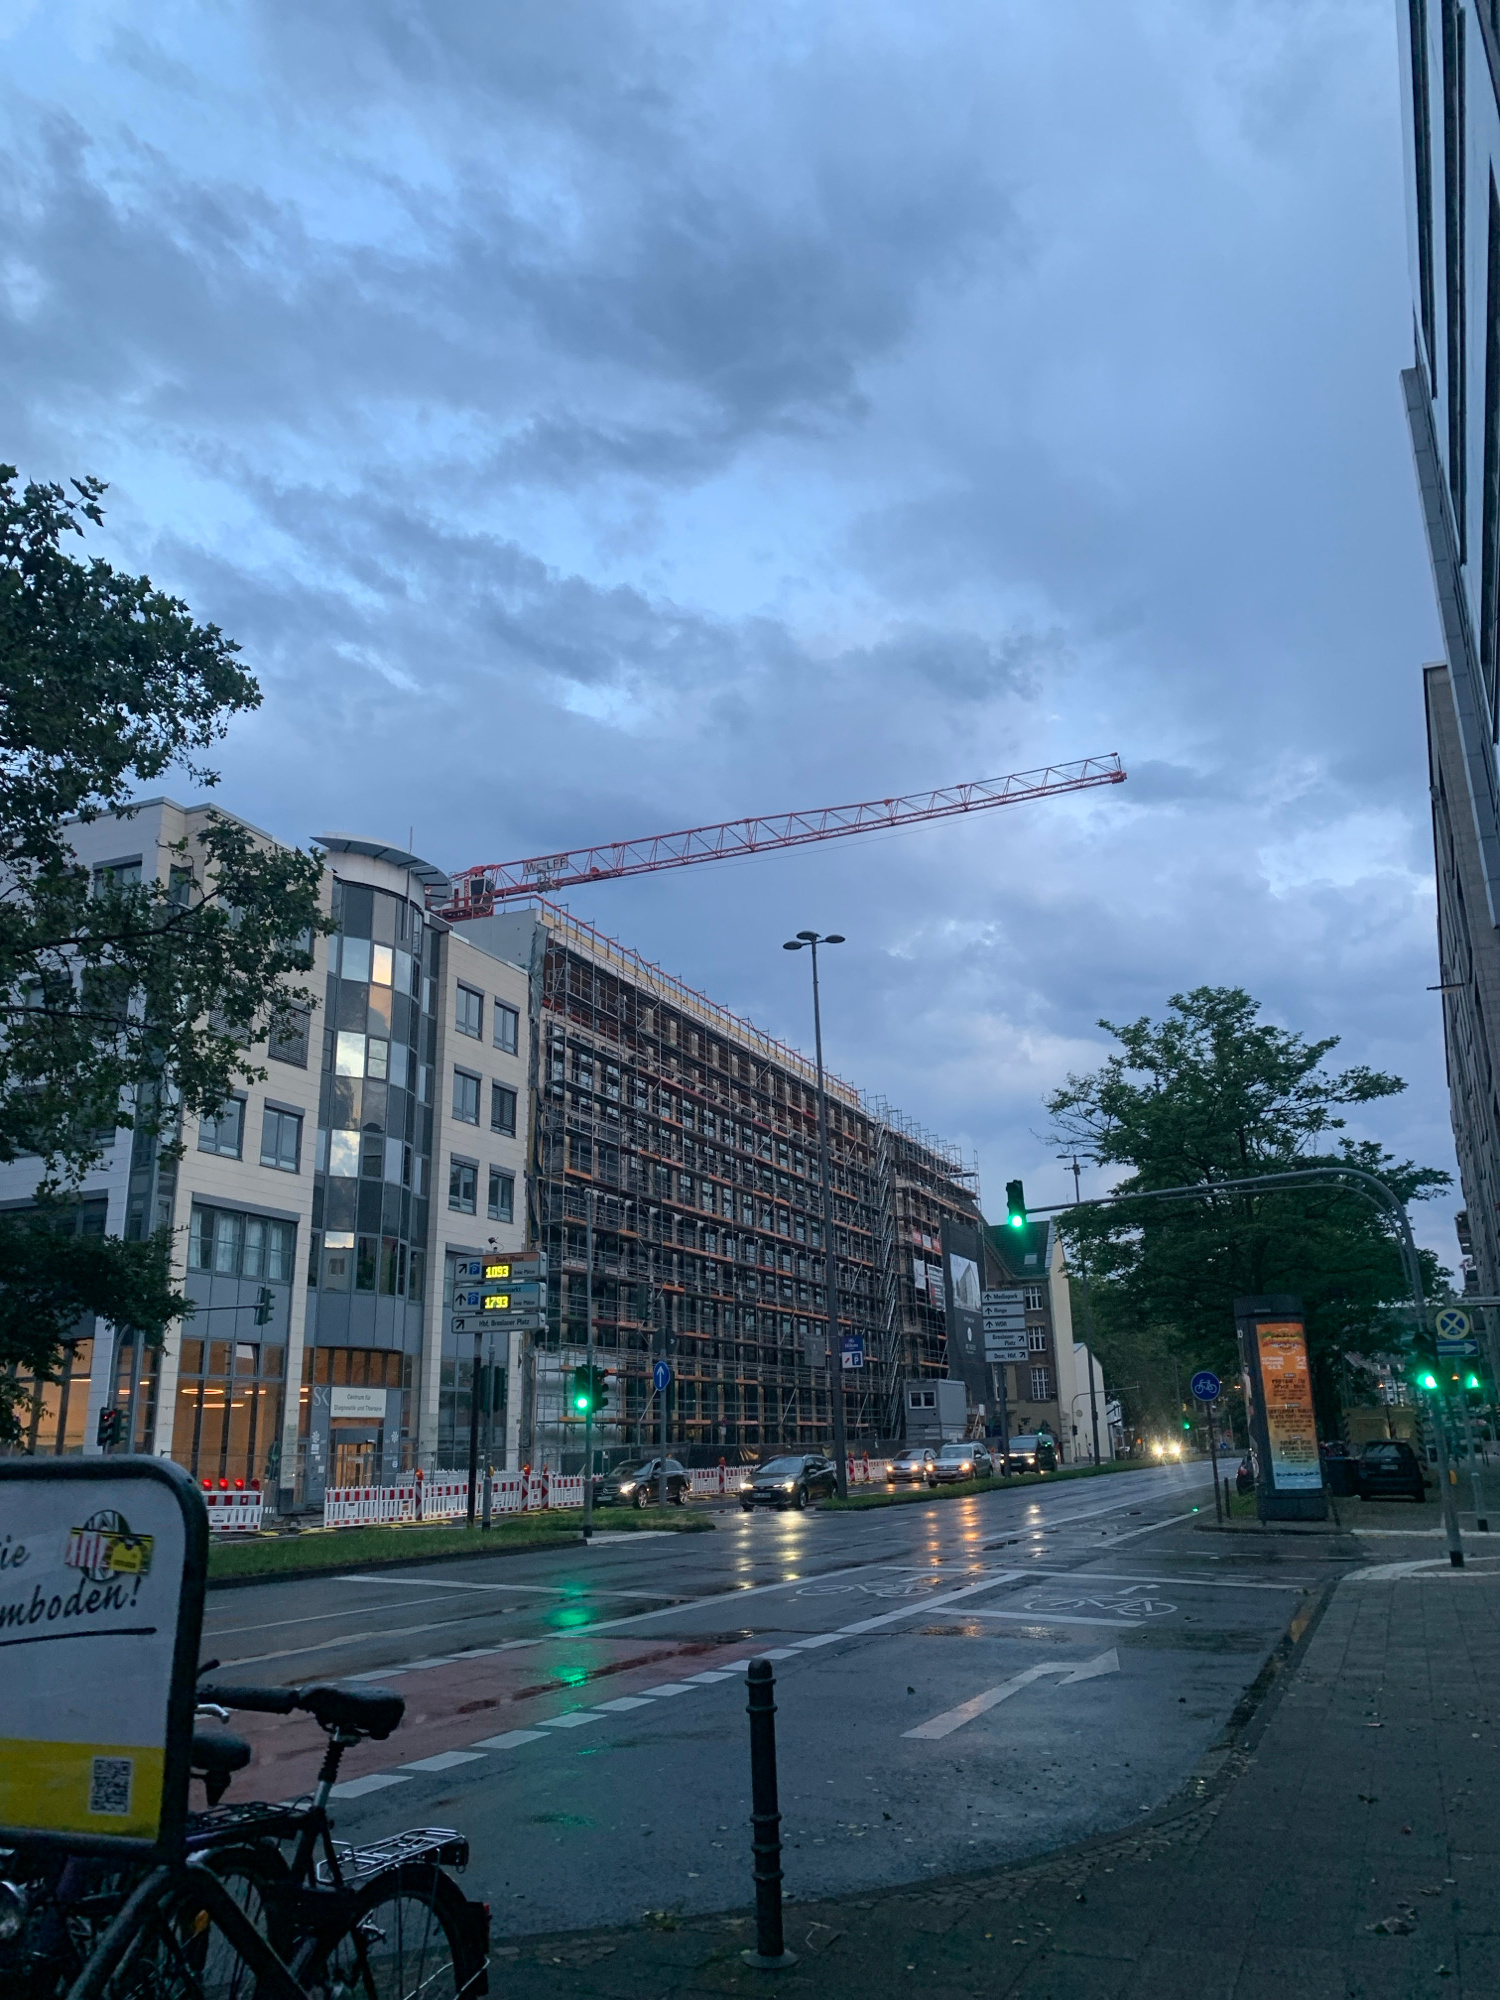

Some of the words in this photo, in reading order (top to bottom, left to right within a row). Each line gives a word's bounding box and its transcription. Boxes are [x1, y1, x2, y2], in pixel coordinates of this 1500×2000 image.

[486, 1265, 509, 1278] 1093
[484, 1296, 508, 1309] 1793
[0, 1534, 30, 1571] ie
